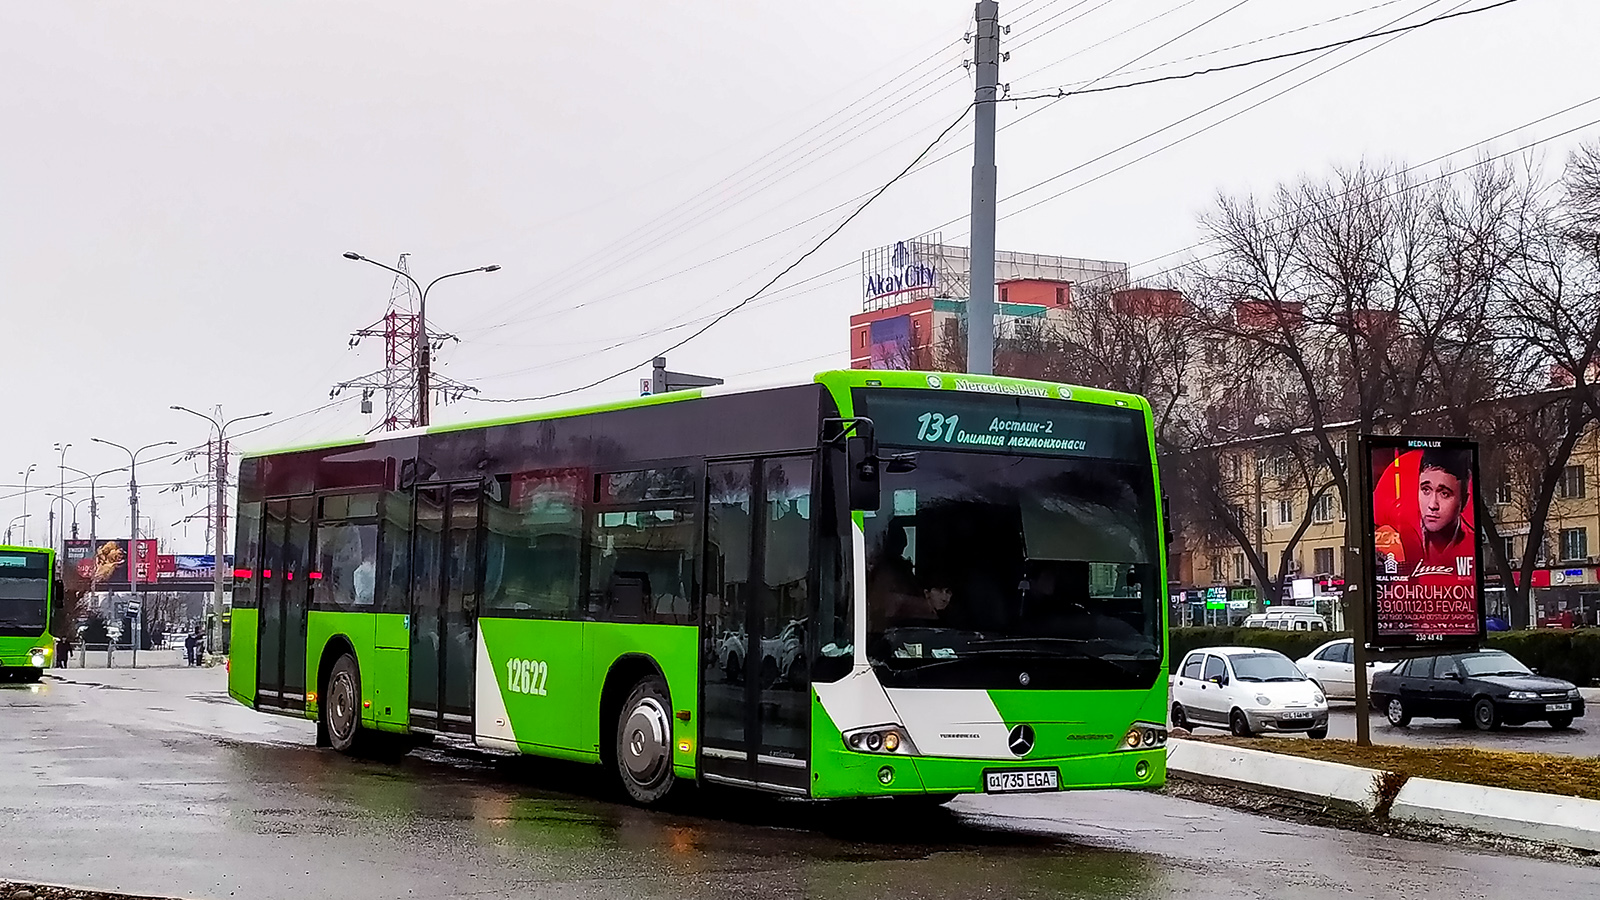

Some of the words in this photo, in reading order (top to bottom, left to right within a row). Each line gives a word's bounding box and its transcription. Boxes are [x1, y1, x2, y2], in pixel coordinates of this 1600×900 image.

[865, 273, 903, 298] Akay
[905, 263, 936, 288] City
[916, 412, 960, 443] 131
[989, 416, 1054, 434] Достлик-2
[956, 430, 1005, 447] Олимпия
[1007, 435, 1087, 451] мехмонхонаси
[1456, 556, 1474, 576] WF
[1376, 584, 1475, 600] SHOHRUHXON
[1436, 600, 1475, 613] FEVRAL
[507, 658, 547, 696] 12622
[989, 776, 1001, 787] 01
[1002, 773, 1024, 788] 735
[1026, 772, 1051, 787] EGA
